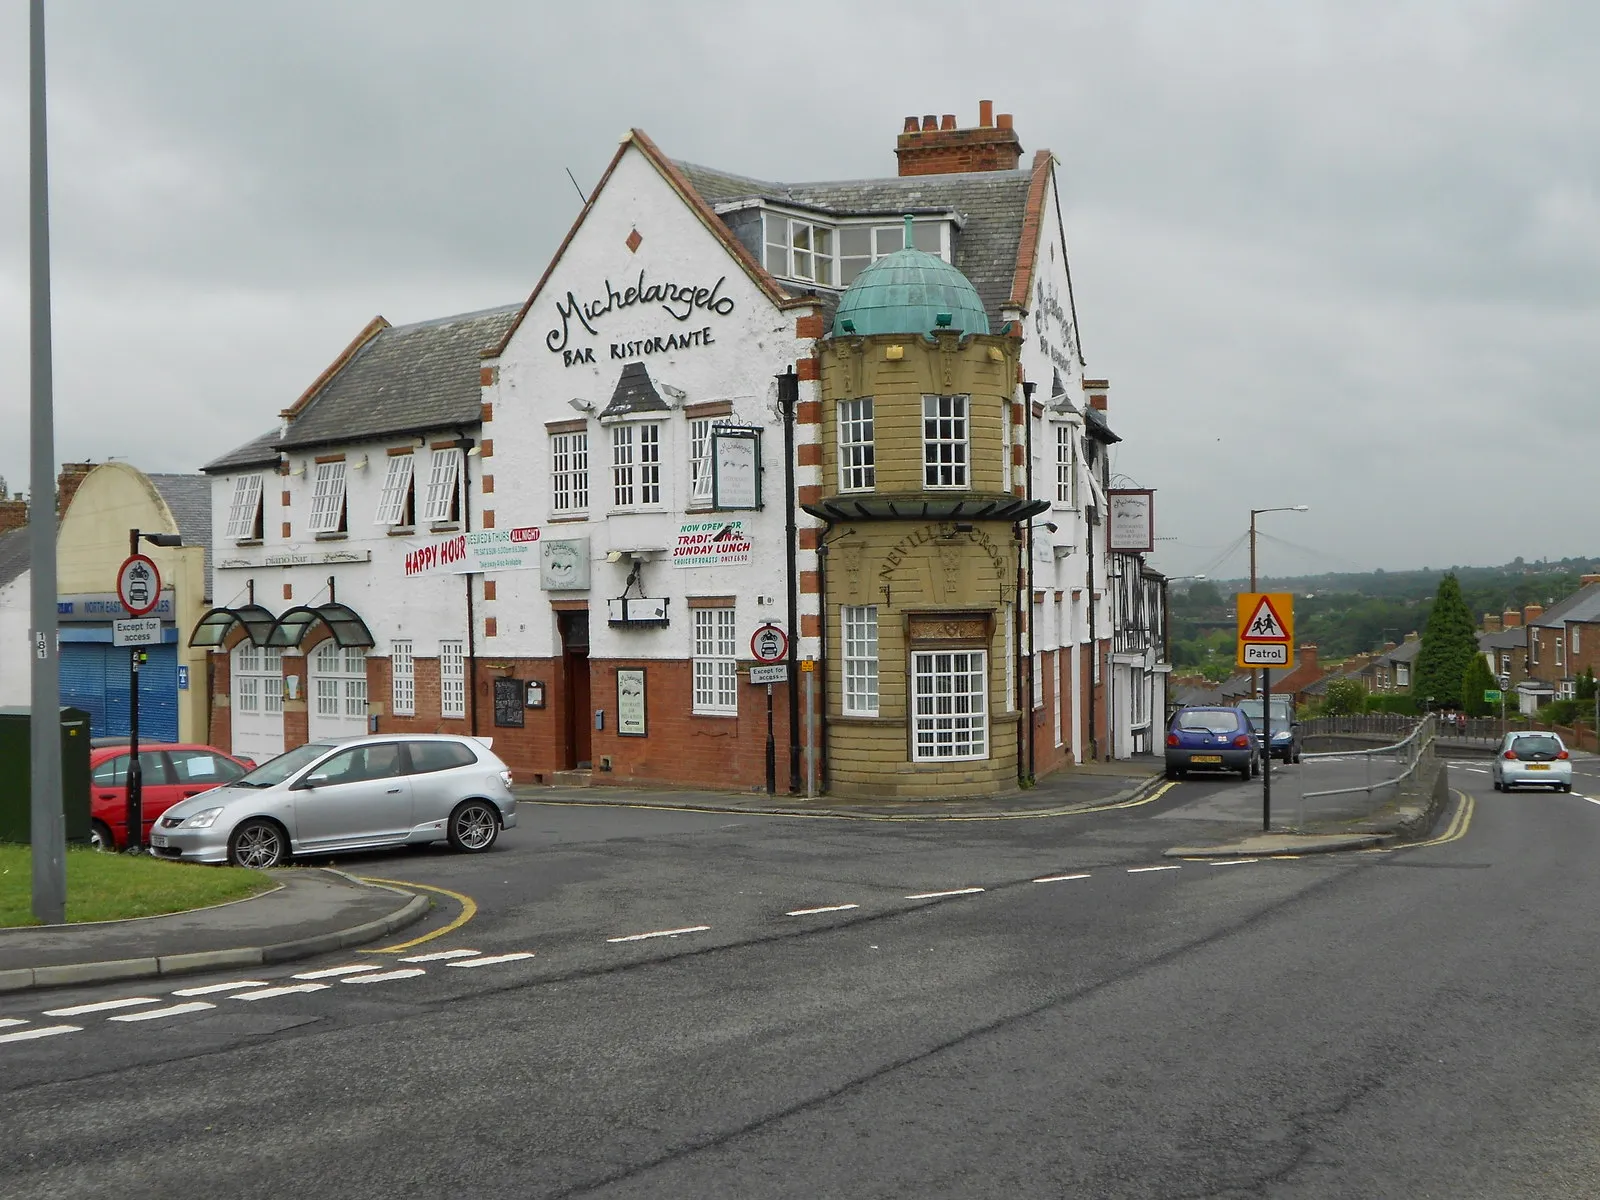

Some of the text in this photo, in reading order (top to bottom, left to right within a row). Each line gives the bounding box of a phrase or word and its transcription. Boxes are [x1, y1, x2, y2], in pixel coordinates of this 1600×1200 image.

[546, 268, 734, 353] Michelangelo
[563, 327, 715, 367] BAR RISTORANTE
[680, 524, 700, 533] NOW
[702, 522, 724, 531] OPEN
[511, 531, 522, 541] ALL
[522, 528, 539, 540] NIGHT
[405, 535, 466, 576] HAPPY HOUR
[673, 542, 751, 556] SUNDAY LUNCH
[265, 553, 308, 566] piano bar
[698, 556, 718, 564] ROASTS
[84, 601, 105, 613] NORTH
[105, 600, 121, 613] EAST
[117, 621, 157, 632] Except for
[124, 633, 151, 642] access
[38, 632, 46, 658] 181
[1249, 649, 1282, 659] Patrol
